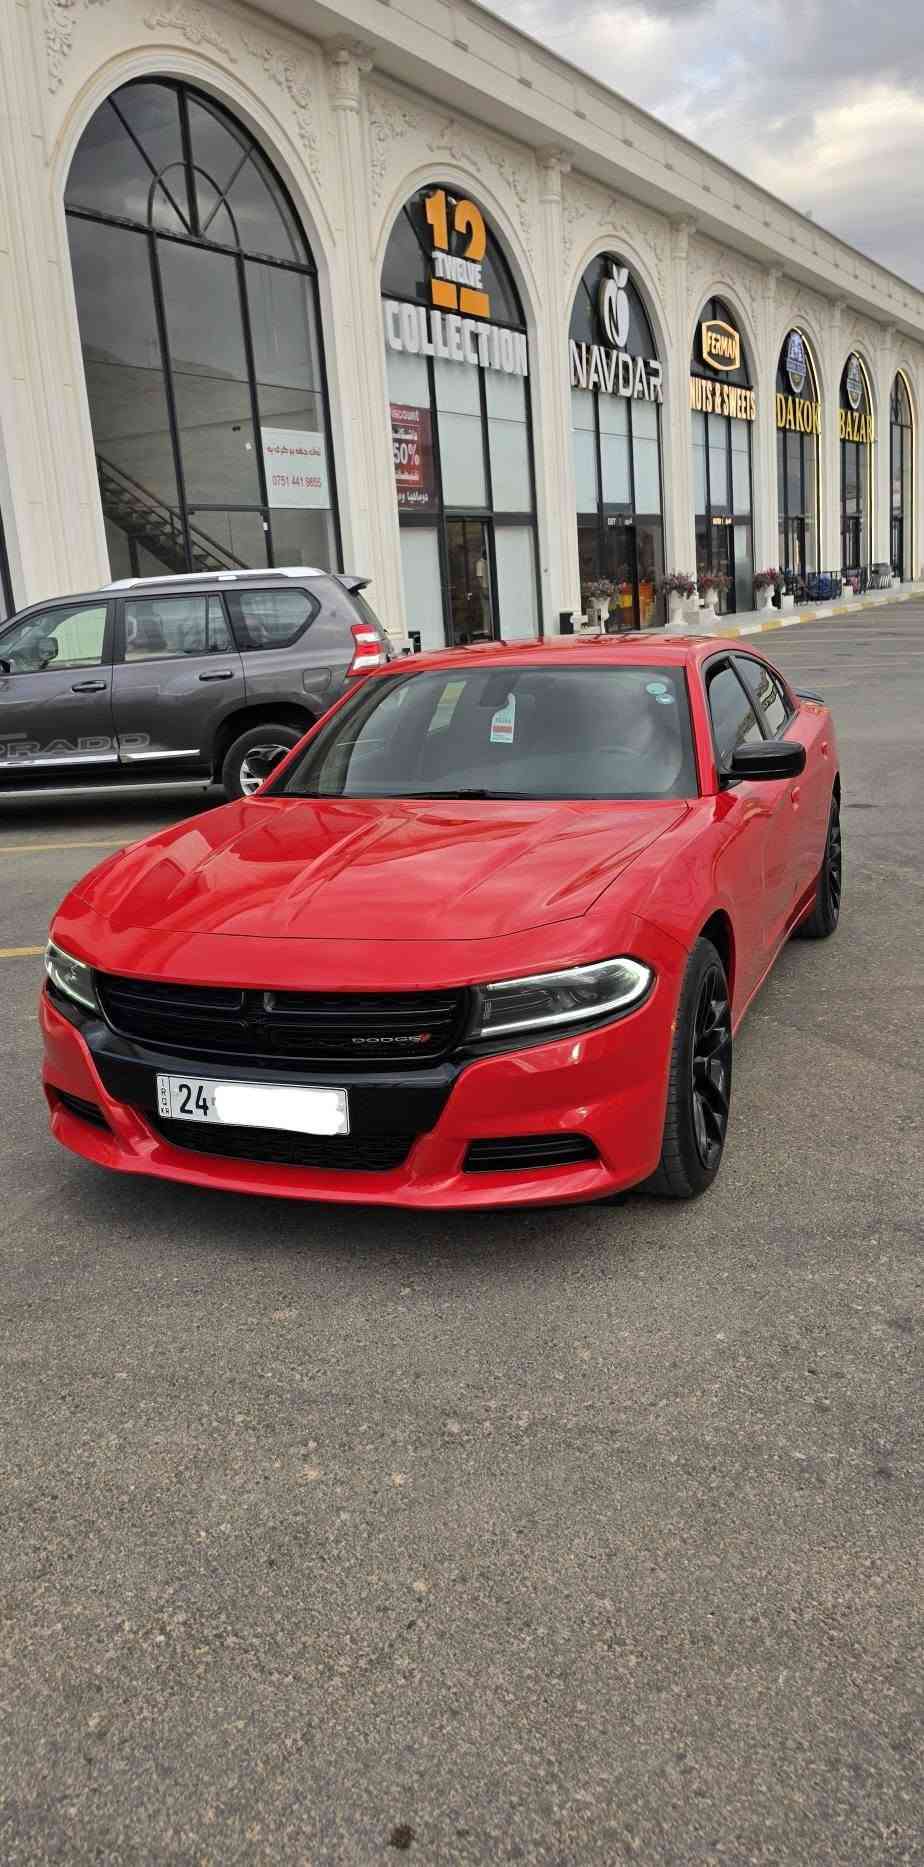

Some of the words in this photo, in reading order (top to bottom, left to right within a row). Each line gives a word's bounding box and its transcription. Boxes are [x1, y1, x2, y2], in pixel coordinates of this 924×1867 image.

[425, 189, 490, 318] 12
[432, 251, 484, 289] TWELVE
[385, 299, 528, 377] COLLECTION
[569, 338, 663, 403] NAVDAR
[689, 376, 713, 412] NUTS
[715, 382, 722, 414] &
[723, 384, 756, 420] SWEETS
[838, 408, 874, 443] BAZAR
[393, 442, 420, 466] 50%
[351, 1035, 421, 1044] DODGE
[178, 1084, 209, 1117] 24
